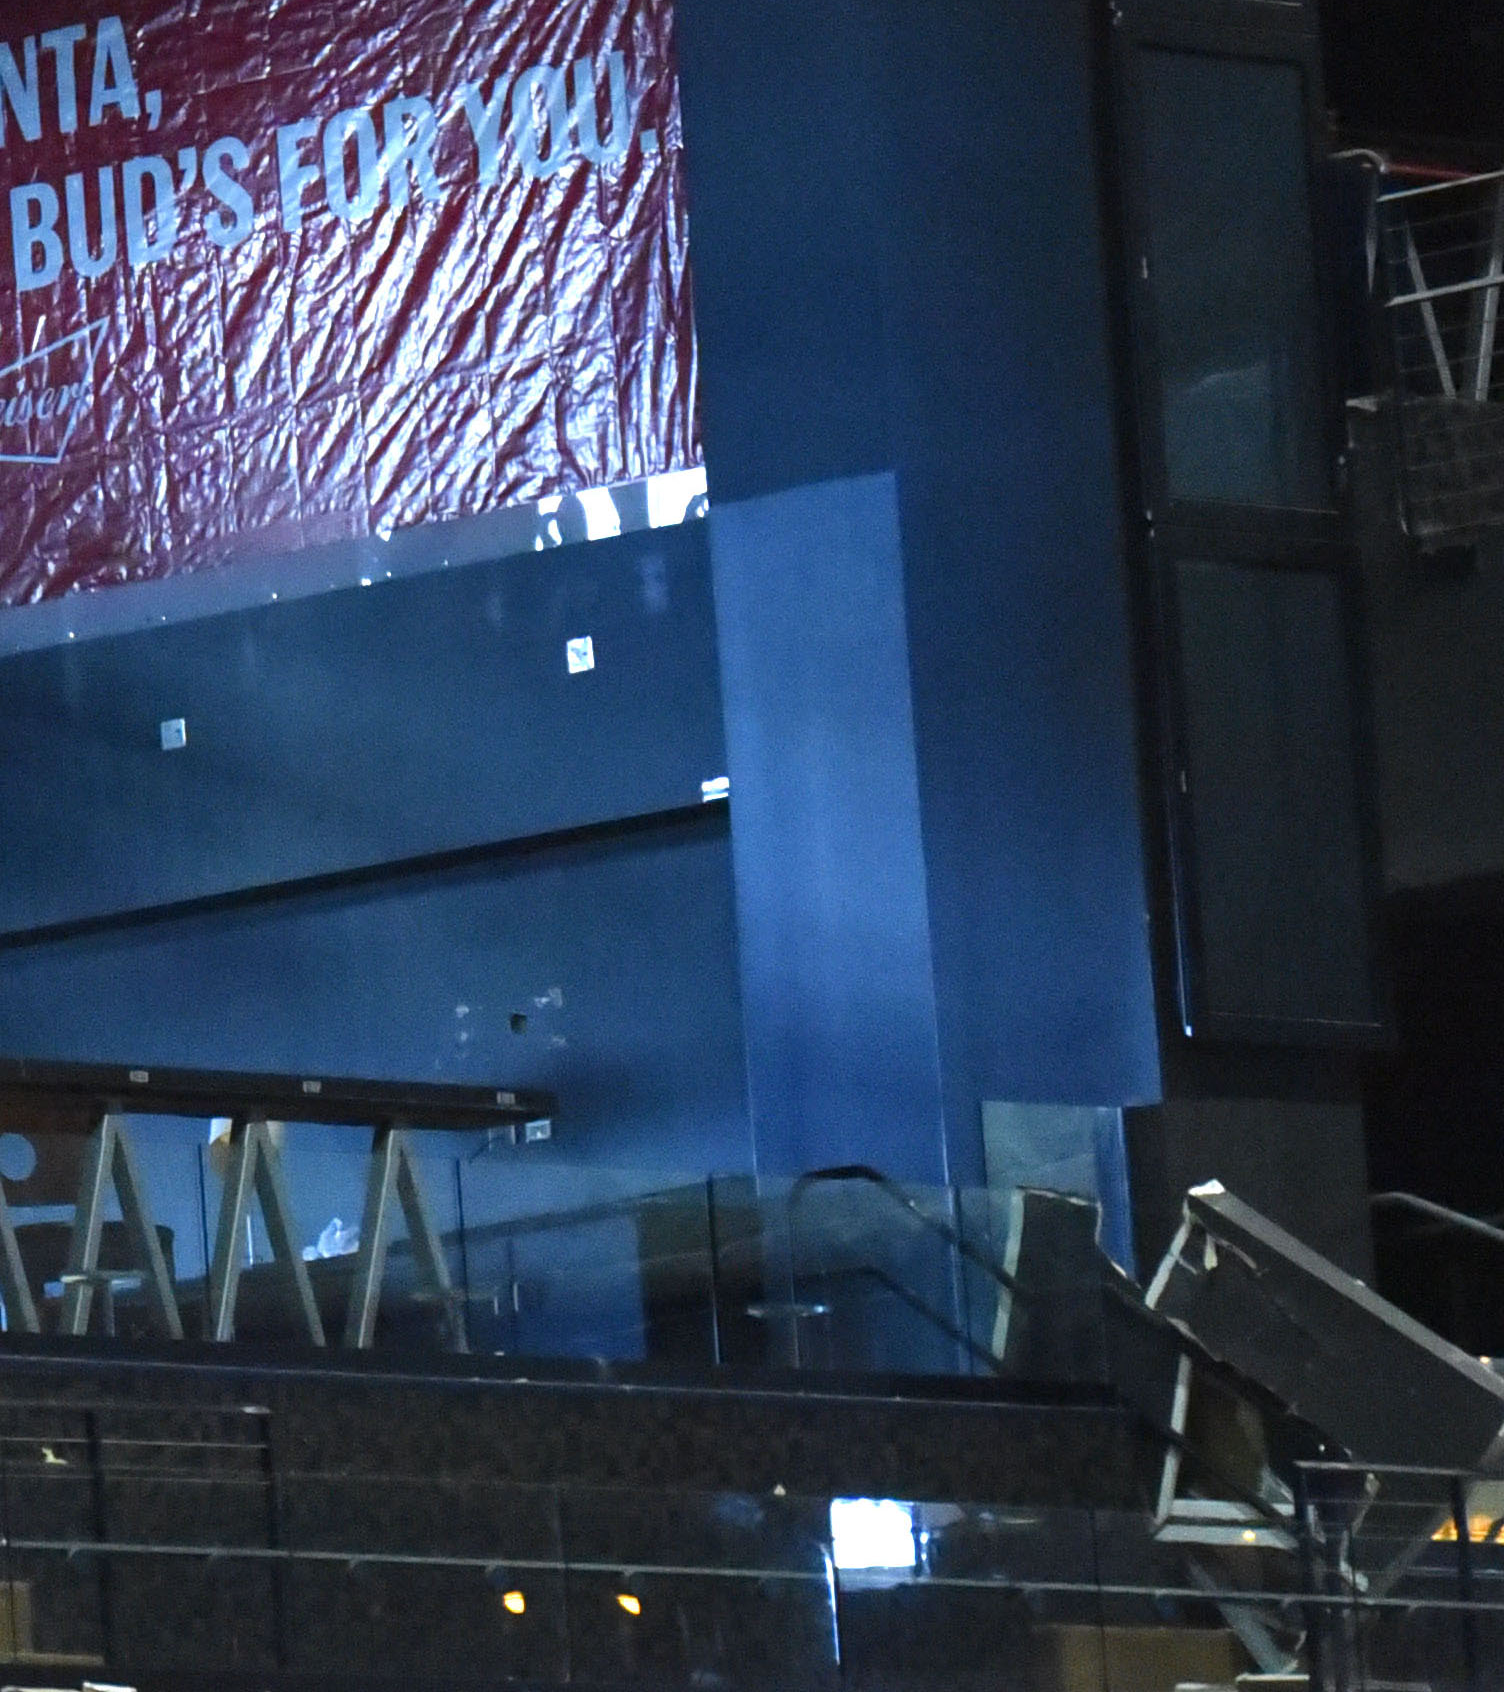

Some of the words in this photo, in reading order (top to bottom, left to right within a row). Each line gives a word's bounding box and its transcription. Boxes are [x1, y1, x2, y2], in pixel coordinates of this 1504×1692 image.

[9, 136, 254, 292] BUD'S
[276, 95, 445, 233] FOR
[462, 49, 658, 186] YOU.
